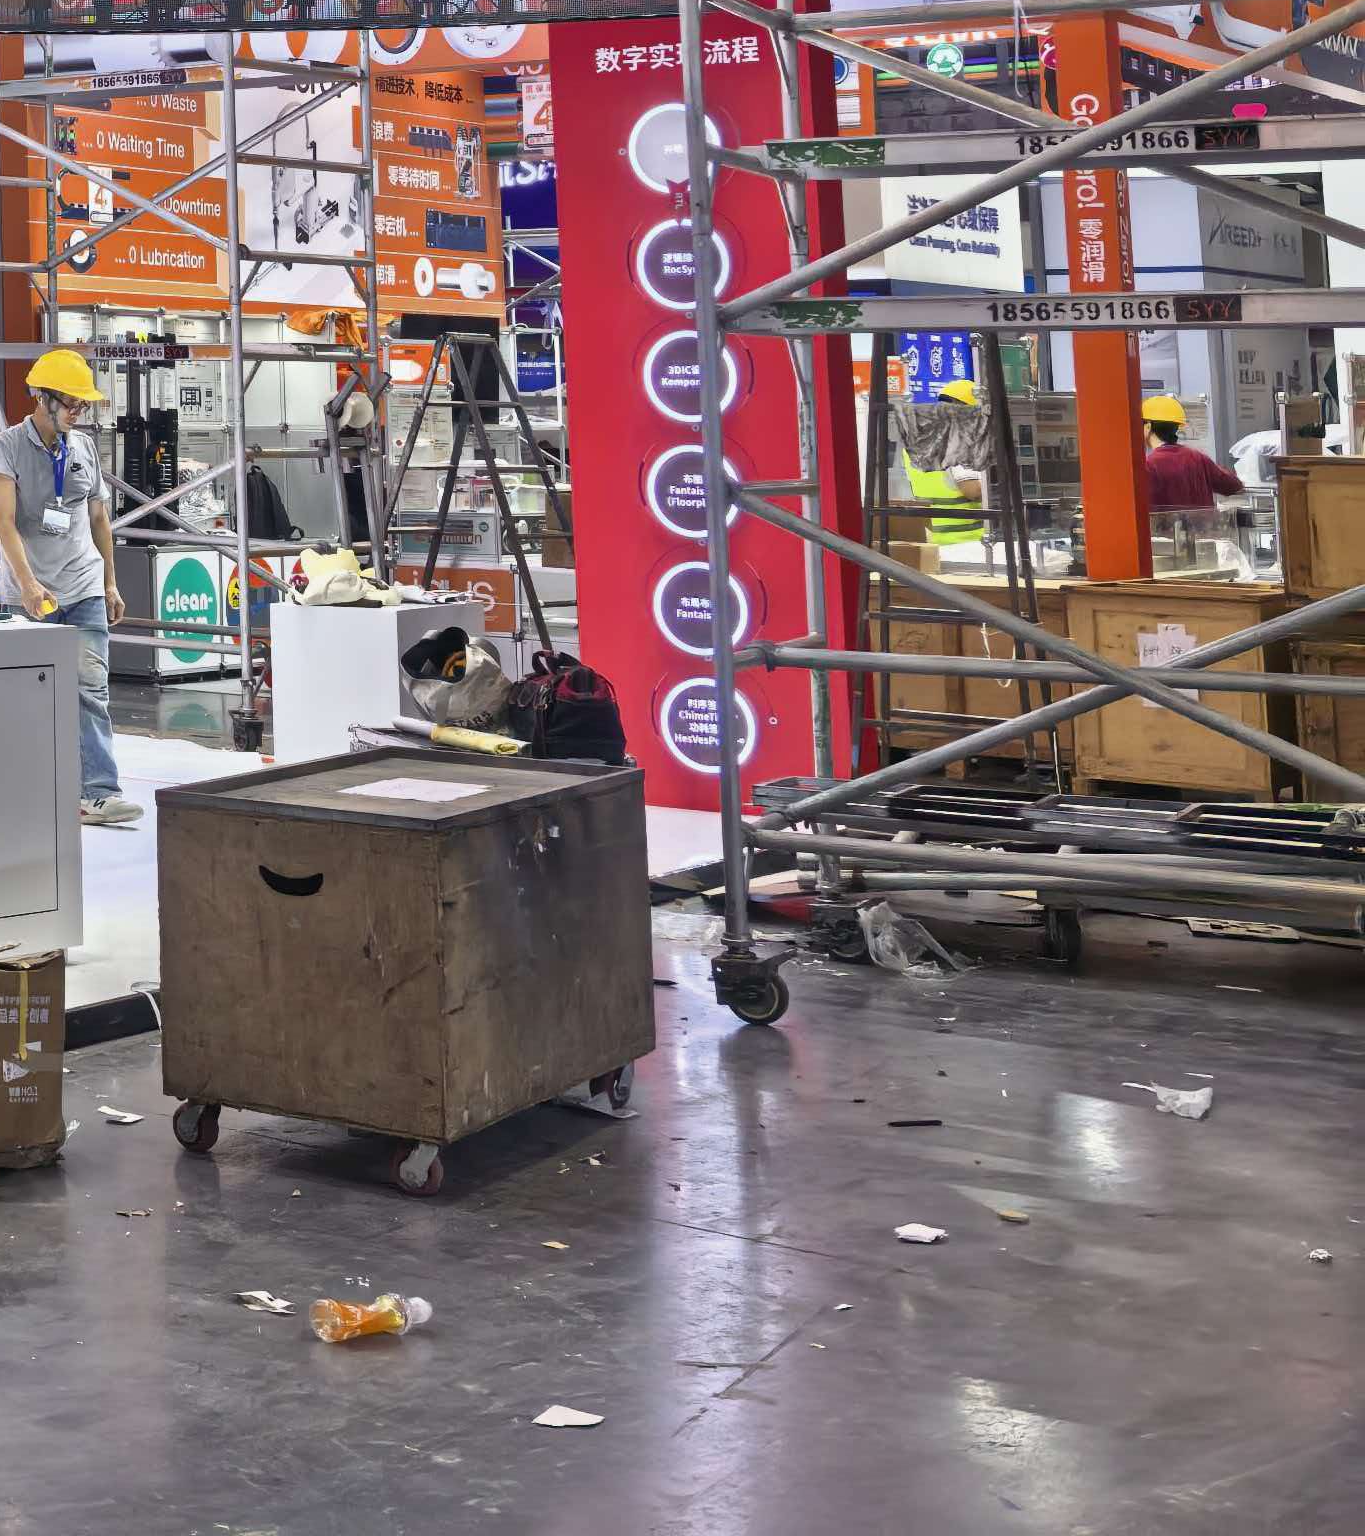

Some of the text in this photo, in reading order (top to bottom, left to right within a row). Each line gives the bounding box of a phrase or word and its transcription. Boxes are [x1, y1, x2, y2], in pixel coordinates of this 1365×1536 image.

[161, 94, 197, 112] Waste
[108, 132, 153, 159] Waiting
[156, 137, 185, 159] Time
[1015, 130, 1190, 155] 18591866
[388, 166, 440, 191] 零等待时间
[140, 244, 206, 270] Lubrication
[1077, 218, 1106, 283] 零润滑
[661, 378, 701, 387] Kompon
[670, 486, 705, 496] Fantais
[667, 497, 706, 508] (Floorpl
[166, 589, 214, 613] clean-
[677, 609, 712, 619] Fantais
[678, 711, 718, 721] ChimeTi
